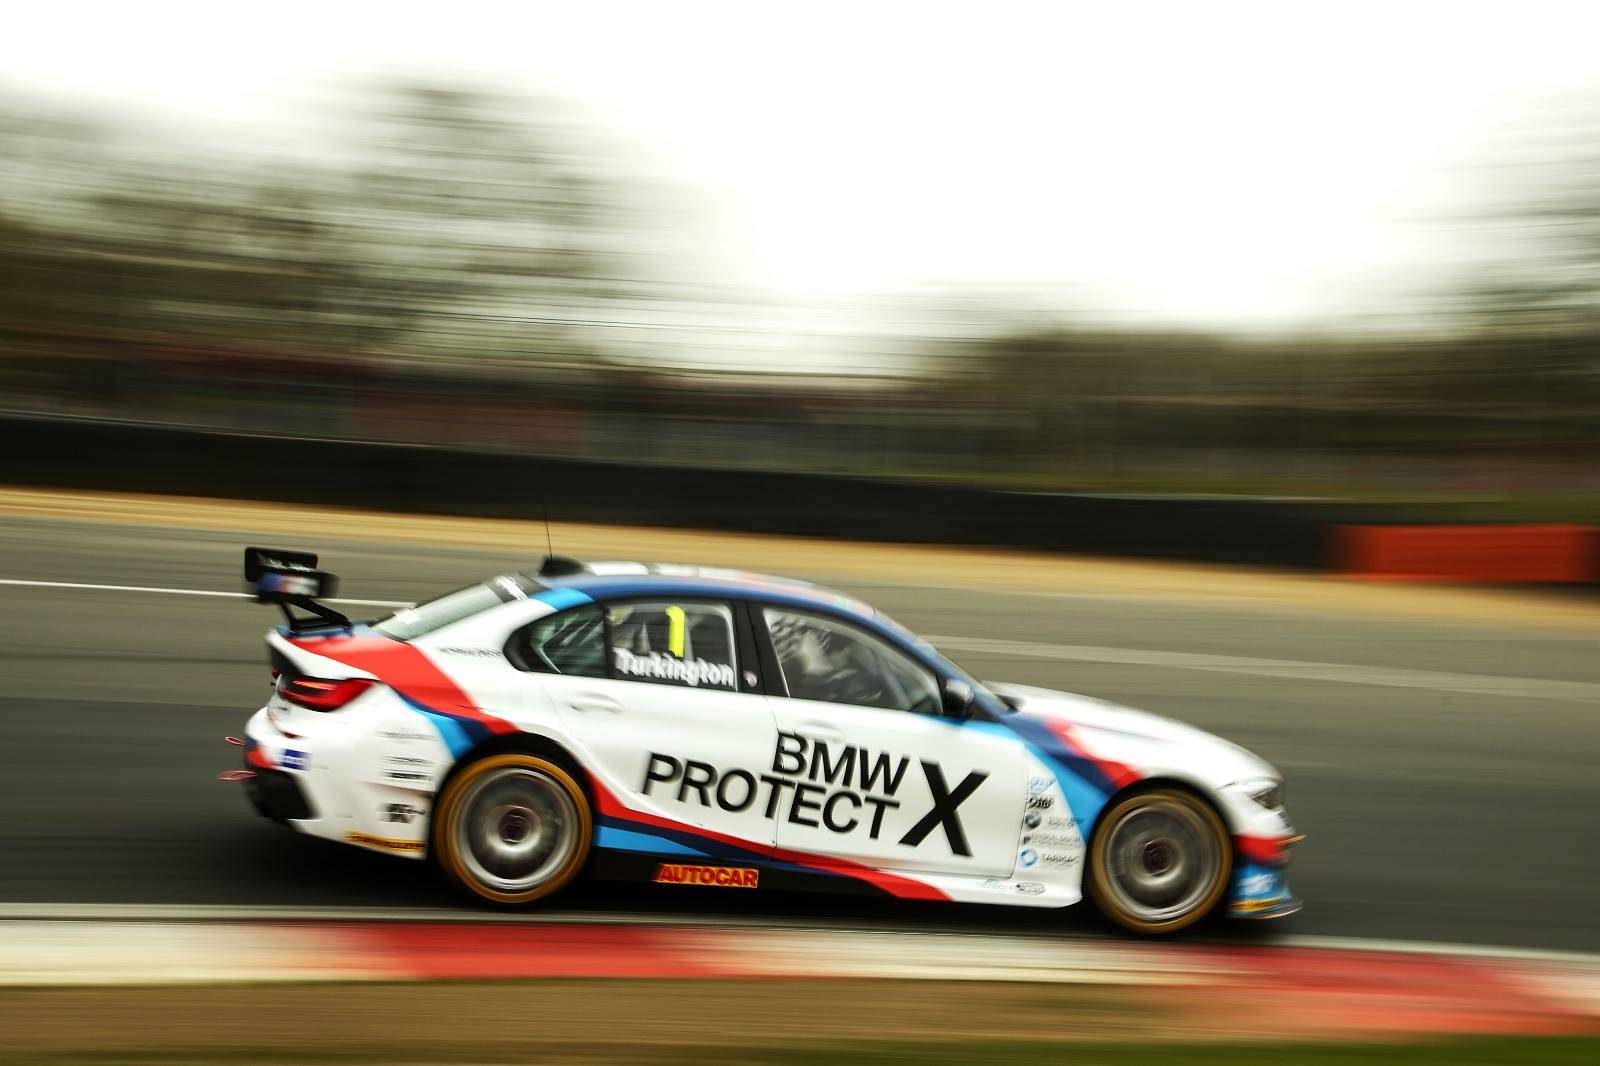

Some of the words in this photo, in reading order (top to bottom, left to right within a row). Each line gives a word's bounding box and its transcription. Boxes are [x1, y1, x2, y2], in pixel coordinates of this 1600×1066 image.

[665, 604, 686, 658] 1
[612, 646, 735, 687] Turkington
[773, 731, 910, 796] BMW
[643, 752, 900, 840] PROTECT
[898, 759, 990, 857] X
[655, 864, 758, 889] AUTOCAR
